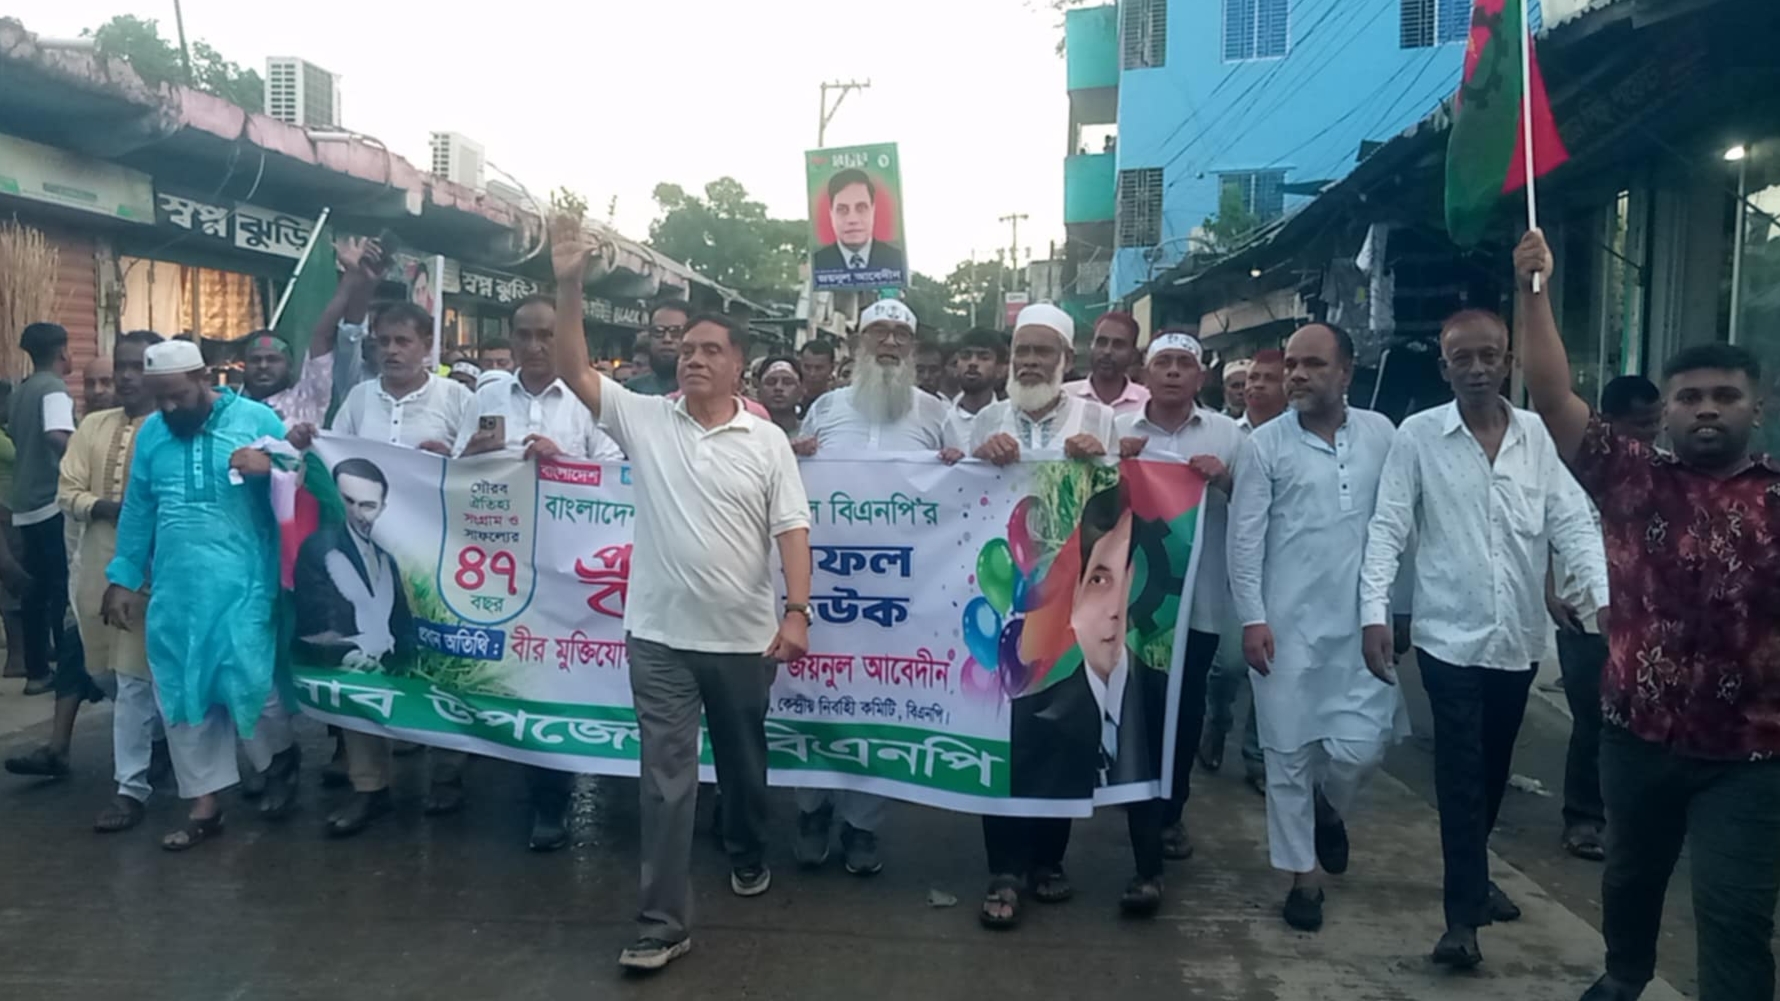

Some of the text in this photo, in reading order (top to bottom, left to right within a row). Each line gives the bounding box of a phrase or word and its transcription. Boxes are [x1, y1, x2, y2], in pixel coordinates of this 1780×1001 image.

[158, 193, 229, 238] স্বপ্ন
[470, 480, 508, 494] গৌরব
[541, 465, 599, 484] বাংলাদেশ
[463, 512, 519, 526] সংগ্রাম ও
[464, 528, 519, 543] সাফল্যের
[455, 546, 517, 595] ৪৭
[781, 545, 914, 578] ফল
[470, 594, 504, 613] বছর
[782, 586, 910, 628] উক
[511, 625, 548, 663] বীর
[555, 630, 630, 673] মুক্তিযো
[787, 653, 855, 692] জয়নুল
[862, 648, 951, 692] আবেদীন
[764, 720, 1004, 788] বিএনপি
